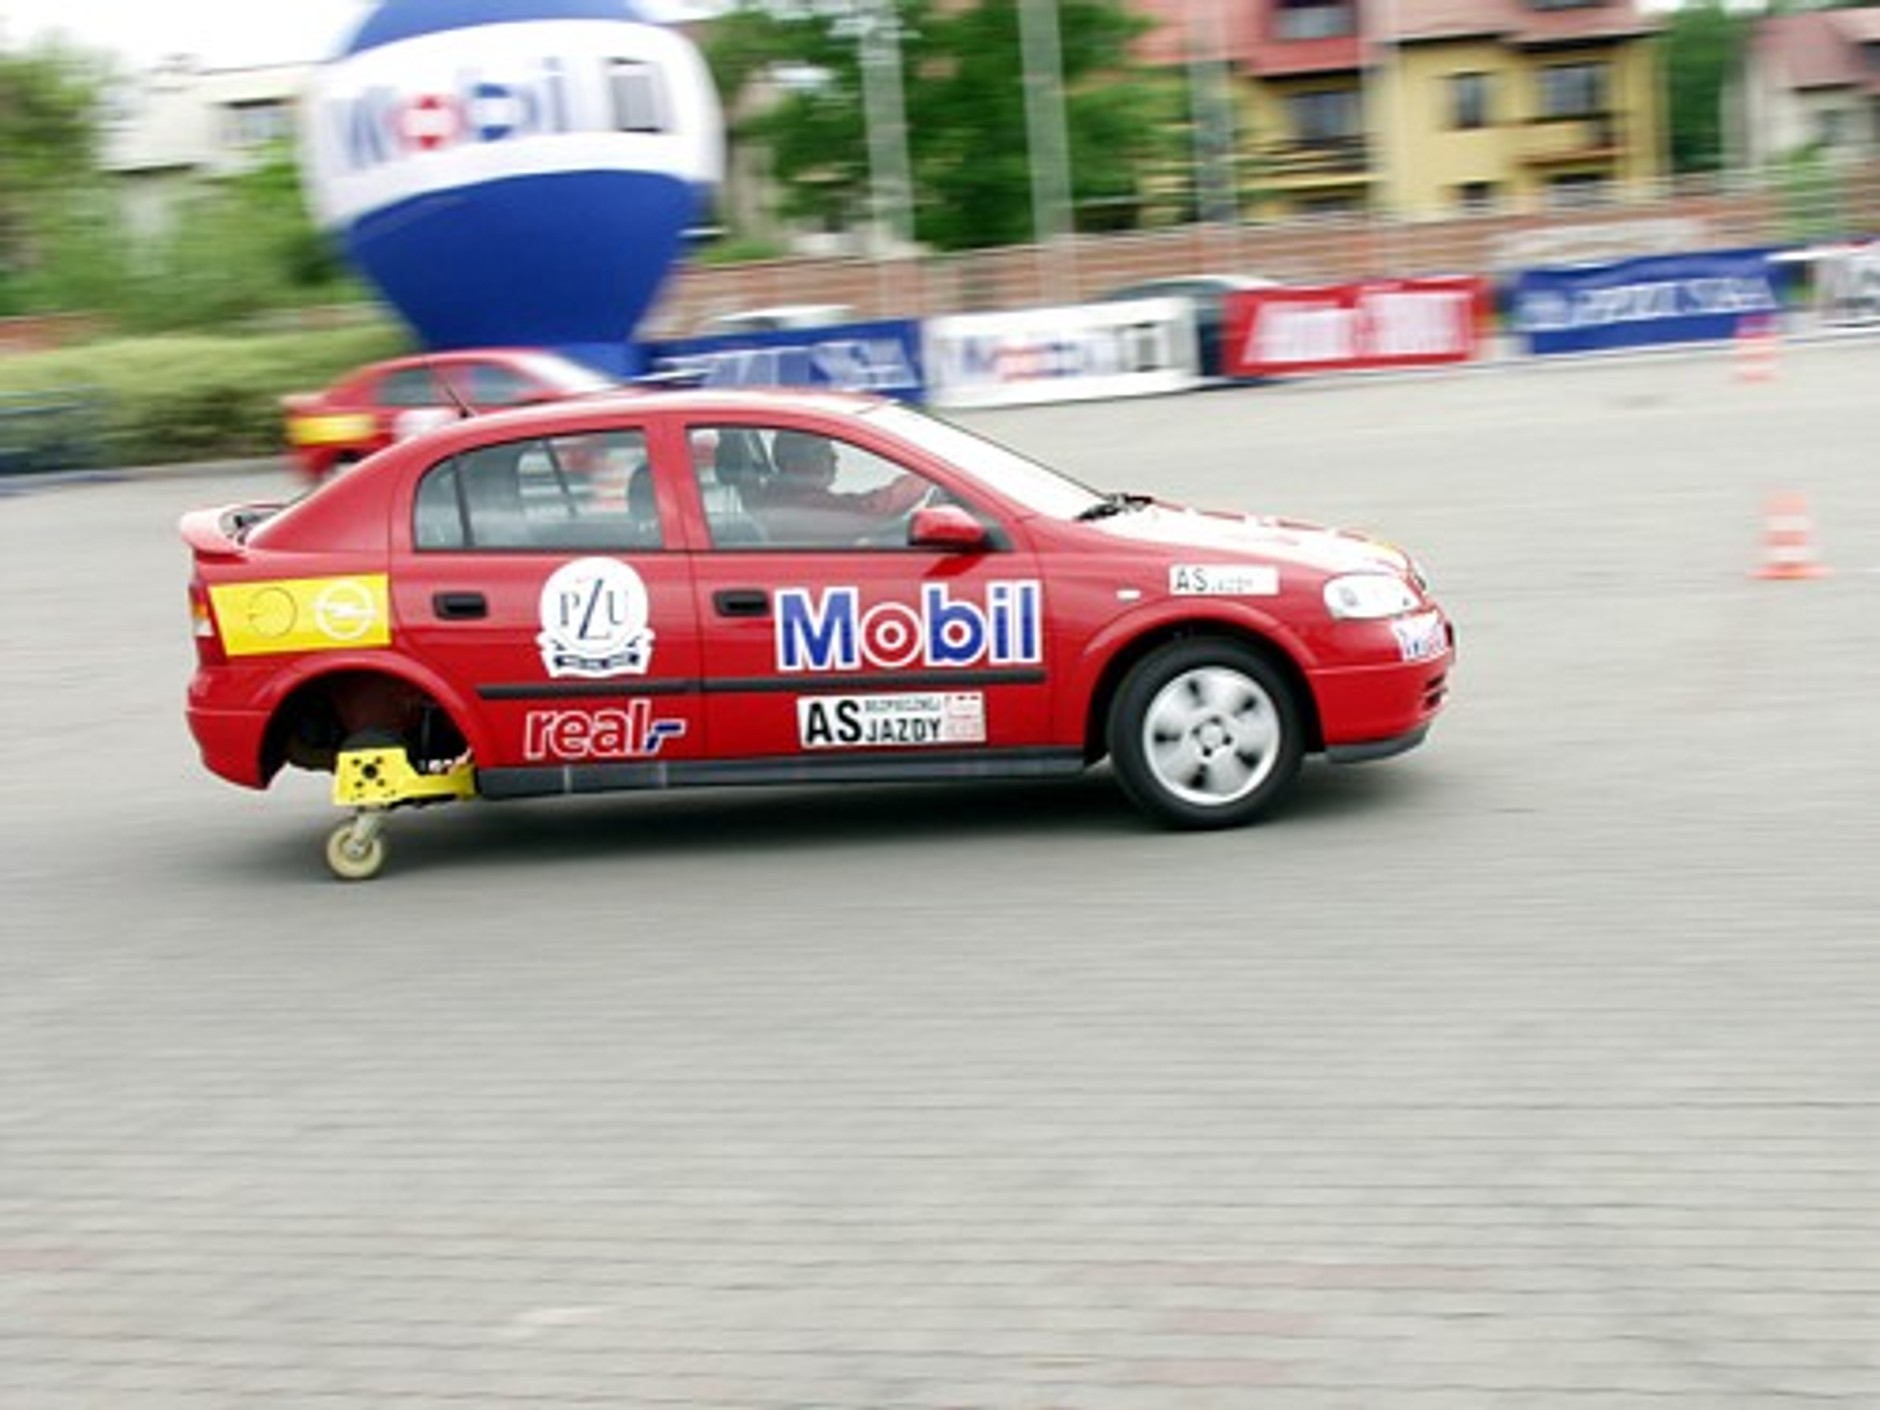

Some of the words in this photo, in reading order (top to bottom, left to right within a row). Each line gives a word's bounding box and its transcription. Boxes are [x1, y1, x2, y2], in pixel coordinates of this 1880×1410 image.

[1174, 567, 1208, 592] AS
[560, 578, 631, 640] PZU
[775, 580, 1042, 671] Mobil
[524, 699, 652, 760] real
[805, 699, 862, 743] AS
[865, 718, 942, 742] JAZDY
